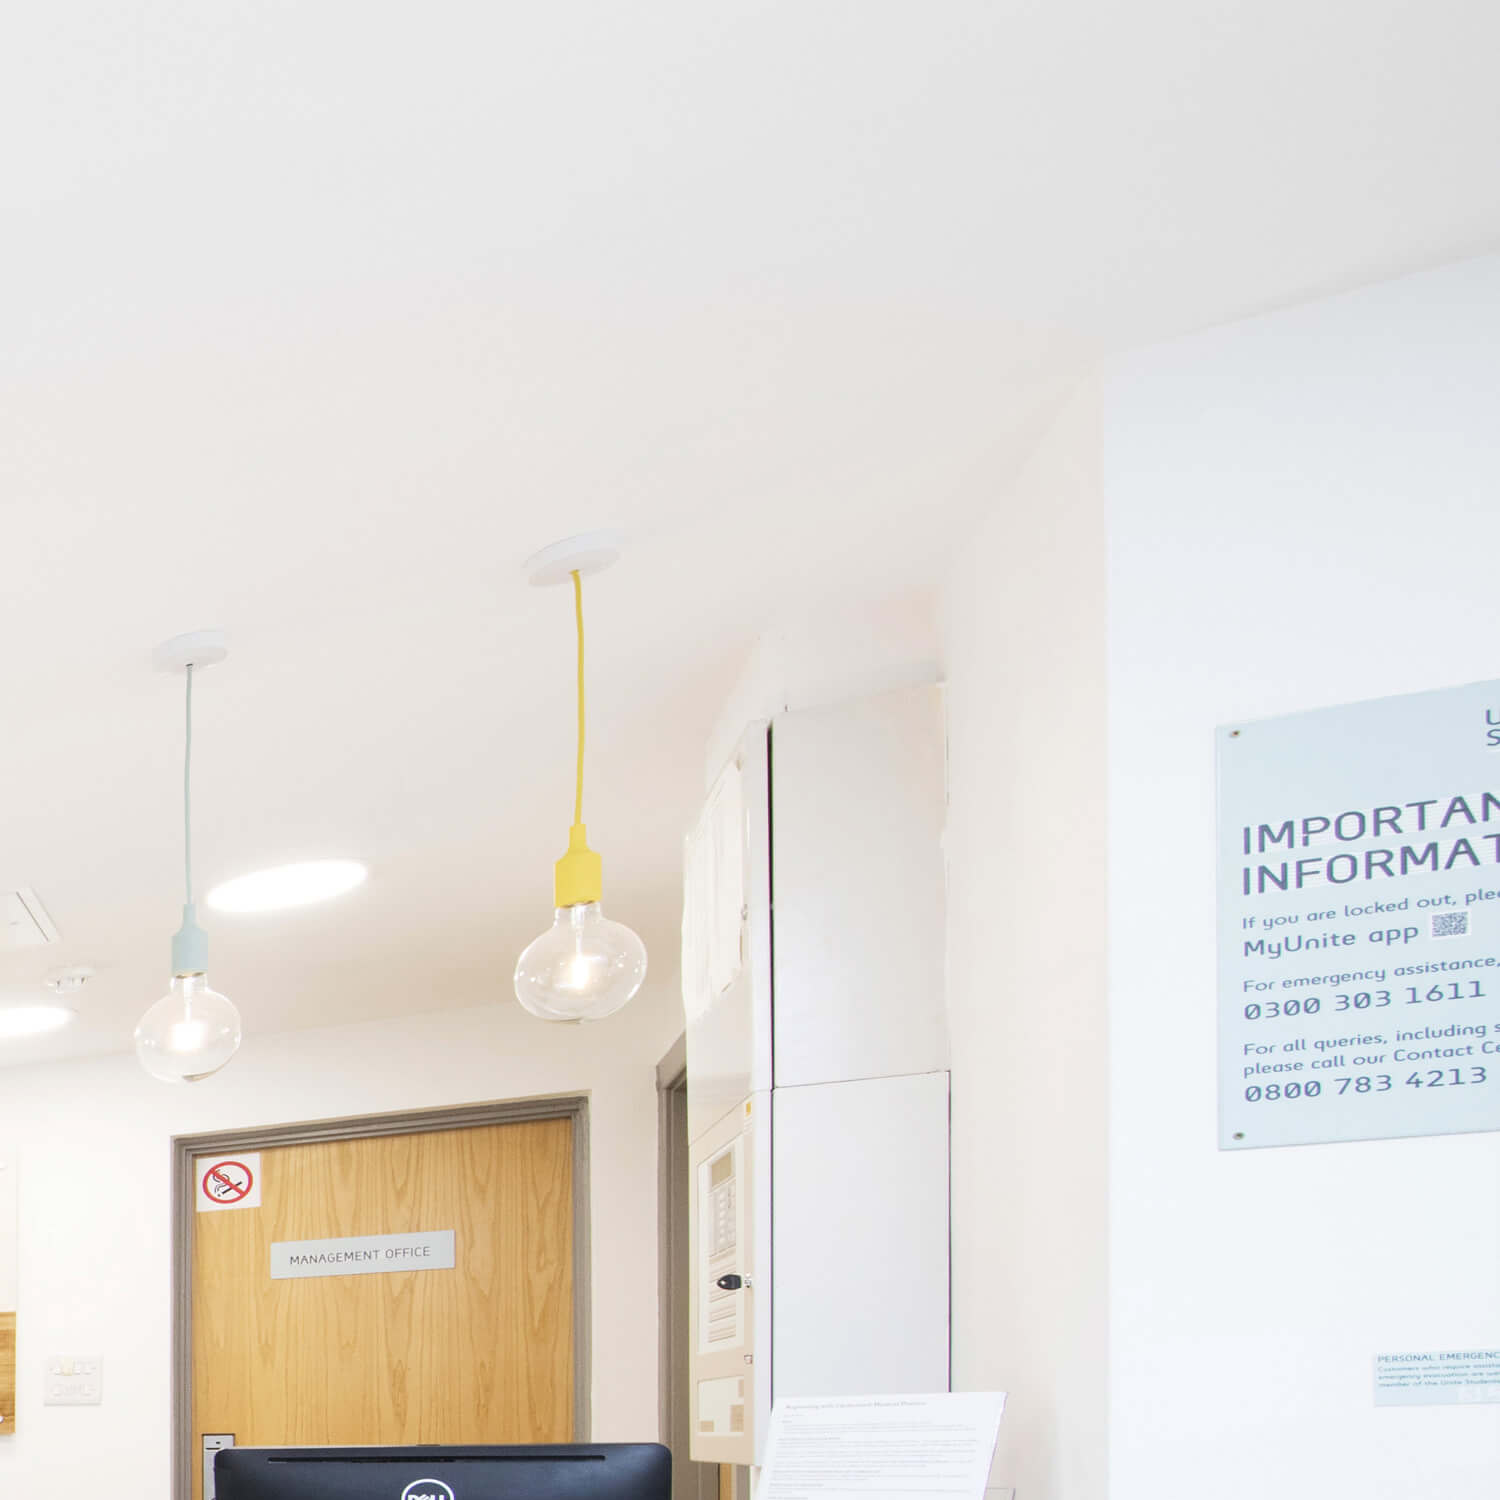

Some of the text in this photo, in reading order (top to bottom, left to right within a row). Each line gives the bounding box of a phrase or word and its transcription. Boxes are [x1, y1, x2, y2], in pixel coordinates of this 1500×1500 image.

[1243, 791, 1500, 856] IMPORTAN
[1243, 888, 1500, 930] If you are locked out, ple
[1243, 926, 1419, 959] MyUnite app
[1243, 980, 1275, 992] For
[1282, 969, 1386, 987] emergency
[1244, 980, 1487, 1020] 0300 303 1611
[1243, 1043, 1276, 1056] For
[1283, 1039, 1306, 1052] all
[1314, 1033, 1388, 1052] queries,
[1396, 1023, 1487, 1042] including
[1243, 1059, 1304, 1079] please
[1311, 1055, 1346, 1070] call
[1353, 1053, 1387, 1066] our
[1394, 1044, 1474, 1062] Contact
[1244, 1066, 1487, 1102] 0800 783 4213
[289, 1246, 431, 1265] MANAGEMENT OFFICE
[1377, 1353, 1433, 1362] PERSONAL
